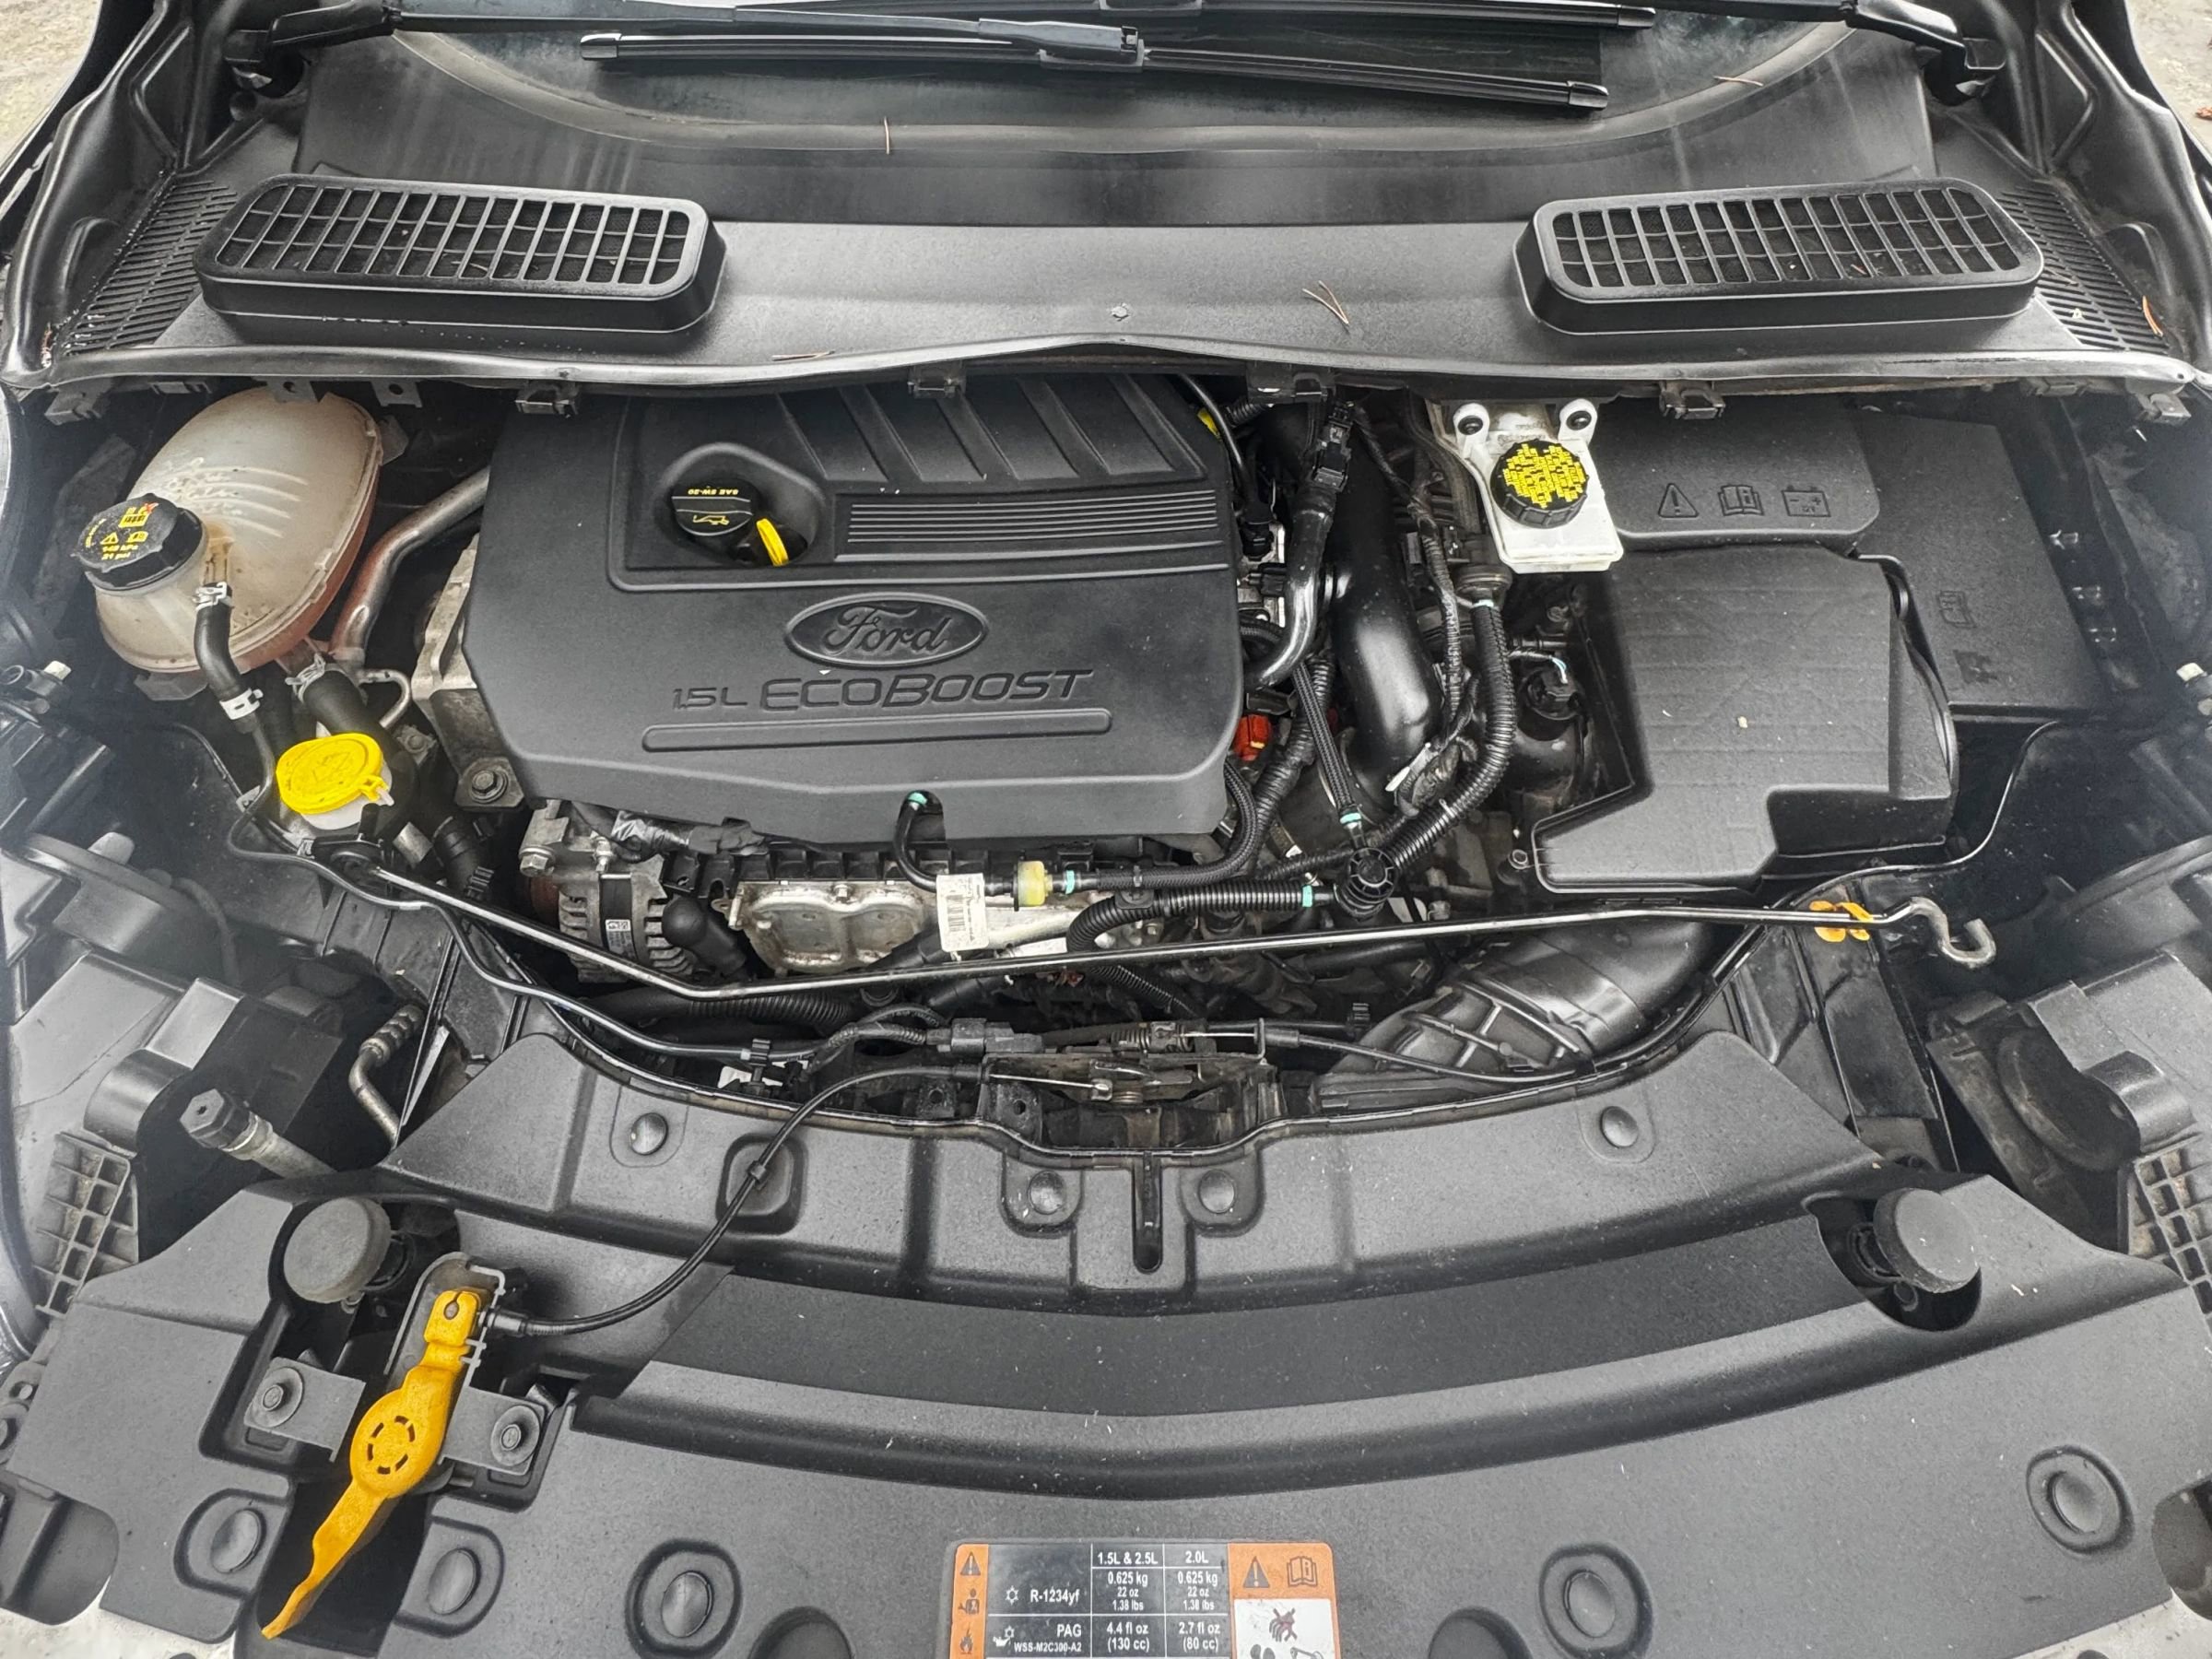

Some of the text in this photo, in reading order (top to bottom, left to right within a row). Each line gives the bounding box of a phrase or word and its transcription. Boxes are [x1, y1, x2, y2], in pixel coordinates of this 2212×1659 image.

[822, 605, 953, 654] Ford
[672, 686, 748, 711] 1.5L
[1097, 1552, 1159, 1565] 1.5L & 2.5L
[1185, 1550, 1209, 1564] 2.0L
[1107, 1571, 1148, 1587] 0.625 kg
[1177, 1571, 1218, 1587] 0.625 kg
[1030, 1588, 1080, 1606] R-1234yf
[1117, 1586, 1139, 1597] 22 oz
[1187, 1586, 1209, 1597] 22 oz
[1112, 1599, 1144, 1611] 1.38 lbs
[1182, 1599, 1215, 1611] 1.38 lbs
[1056, 1623, 1082, 1638] PAG
[1106, 1621, 1149, 1634] 4.4 fl oz
[1179, 1621, 1221, 1634] 2.7 fl oz
[1013, 1641, 1082, 1653] WSS-M2C300-A2
[1107, 1636, 1150, 1653] (130 cc)
[1182, 1636, 1219, 1653] (80 cc)
